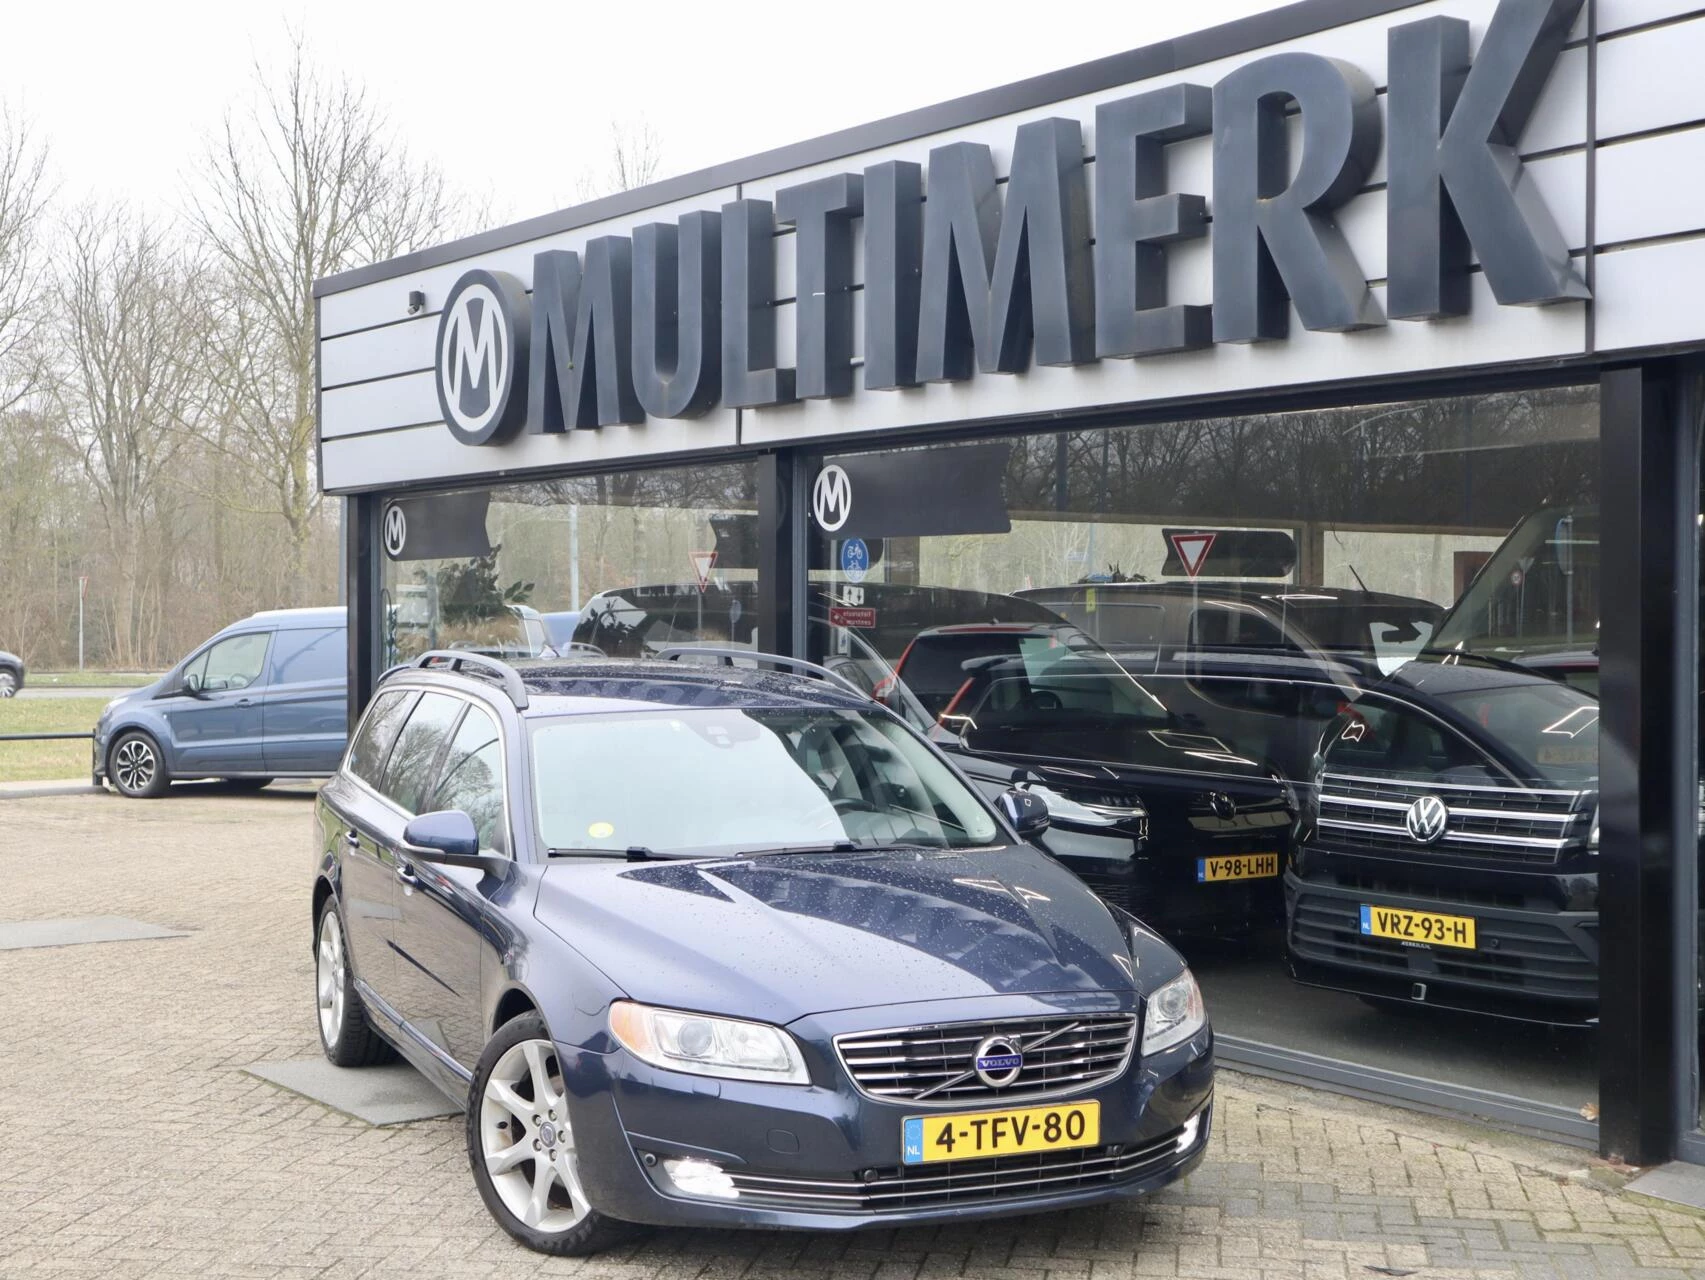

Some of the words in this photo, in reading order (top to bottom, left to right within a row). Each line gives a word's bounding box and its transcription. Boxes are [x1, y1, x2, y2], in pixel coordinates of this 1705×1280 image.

[528, 0, 1592, 434] MULTIMERK
[1209, 856, 1274, 877] V-98-LHH
[1362, 922, 1370, 930] NL
[1377, 911, 1467, 943] VRZ-93-H
[980, 1058, 1020, 1068] VOLVO
[907, 1146, 921, 1156] NL
[935, 1110, 1086, 1154] 4-TFV-80
